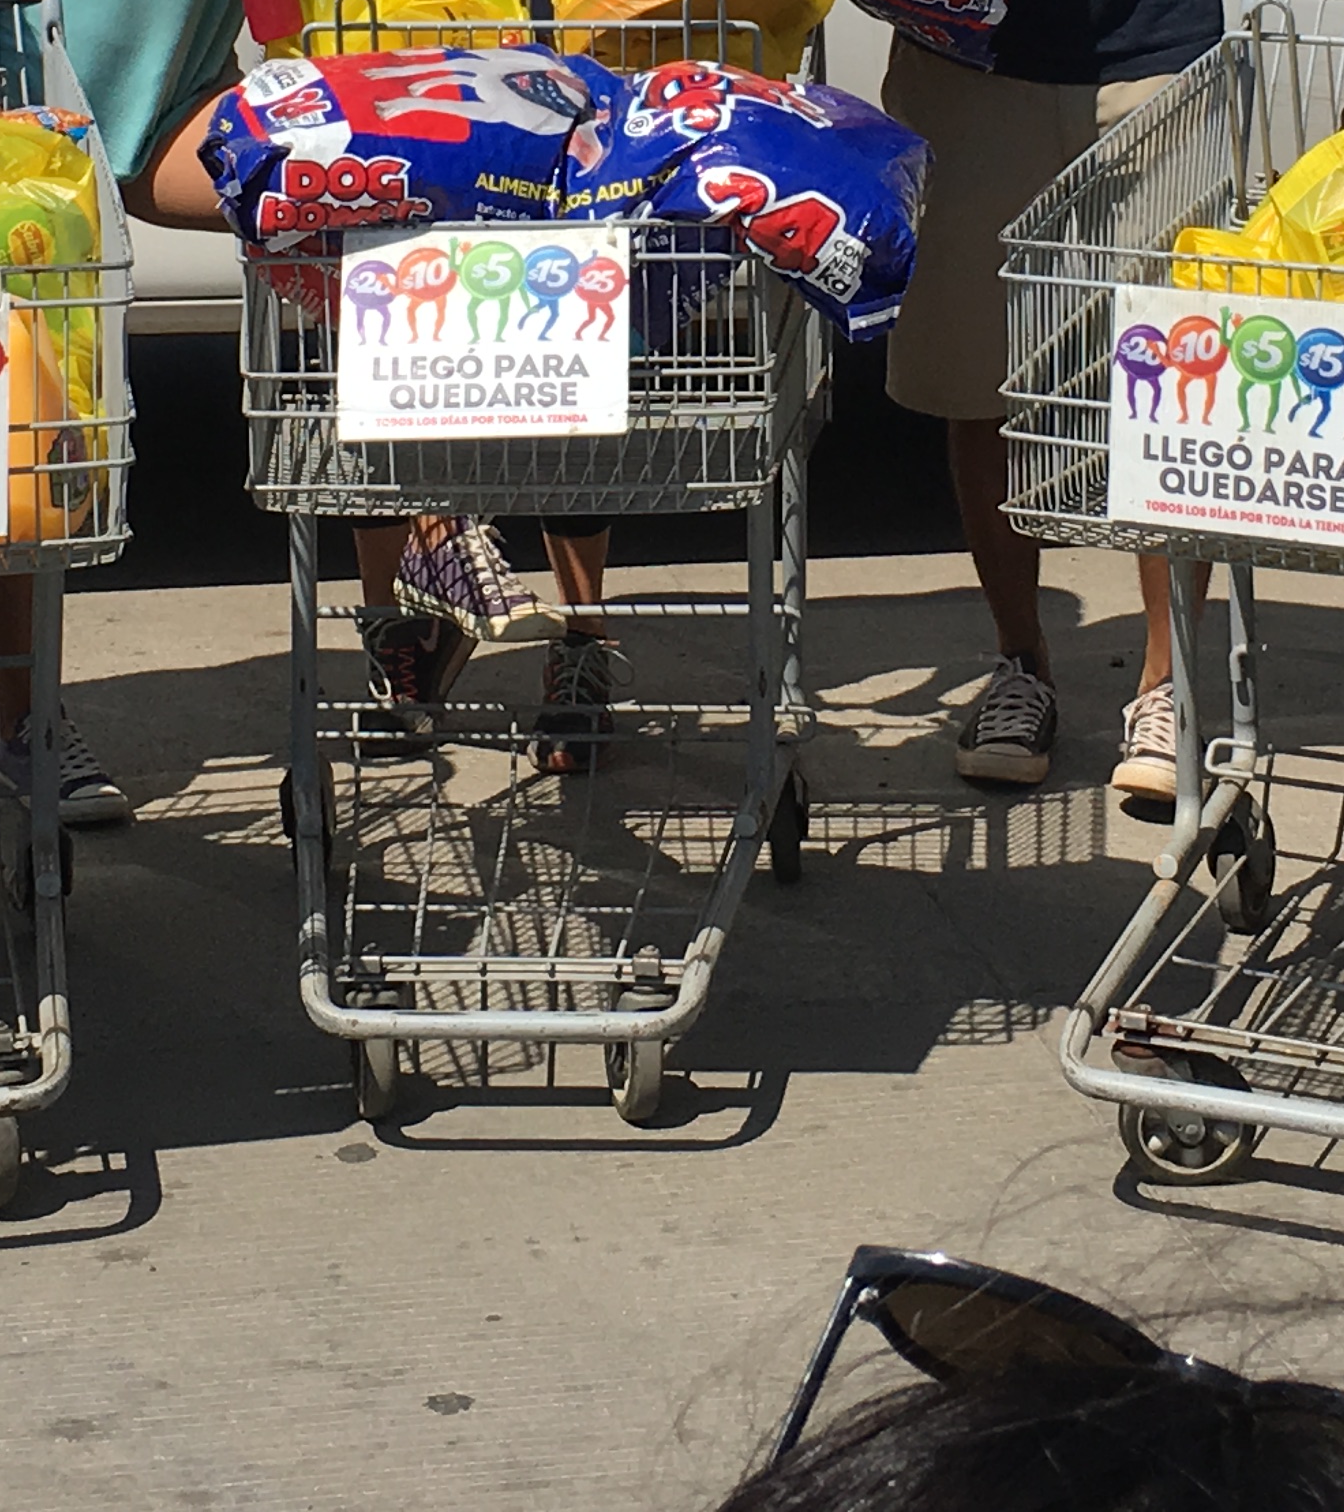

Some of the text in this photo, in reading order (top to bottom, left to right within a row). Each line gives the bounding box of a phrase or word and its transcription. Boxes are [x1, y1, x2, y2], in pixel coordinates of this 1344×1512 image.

[283, 156, 409, 202] DOG
[259, 193, 432, 238] power
[699, 167, 845, 274] 24
[403, 257, 448, 289] $10
[472, 253, 515, 287] $5
[528, 258, 572, 287] $15
[1171, 330, 1219, 363] $10
[1242, 331, 1286, 369] $5
[1300, 343, 1344, 378] $15
[372, 348, 589, 381] LLEGÓ PARA
[389, 382, 578, 409] QUEDARSE
[376, 413, 588, 427] TODOS LOS DÍAS POR TODA LA TIENDA
[1143, 434, 1252, 471] LLEGÓ
[1146, 500, 1182, 514] TODOS
[1186, 504, 1207, 517] LOS
[1210, 505, 1238, 521] DÍAS
[1240, 511, 1263, 523] POR
[1266, 514, 1296, 528] TODA
[1299, 518, 1312, 530] LA
